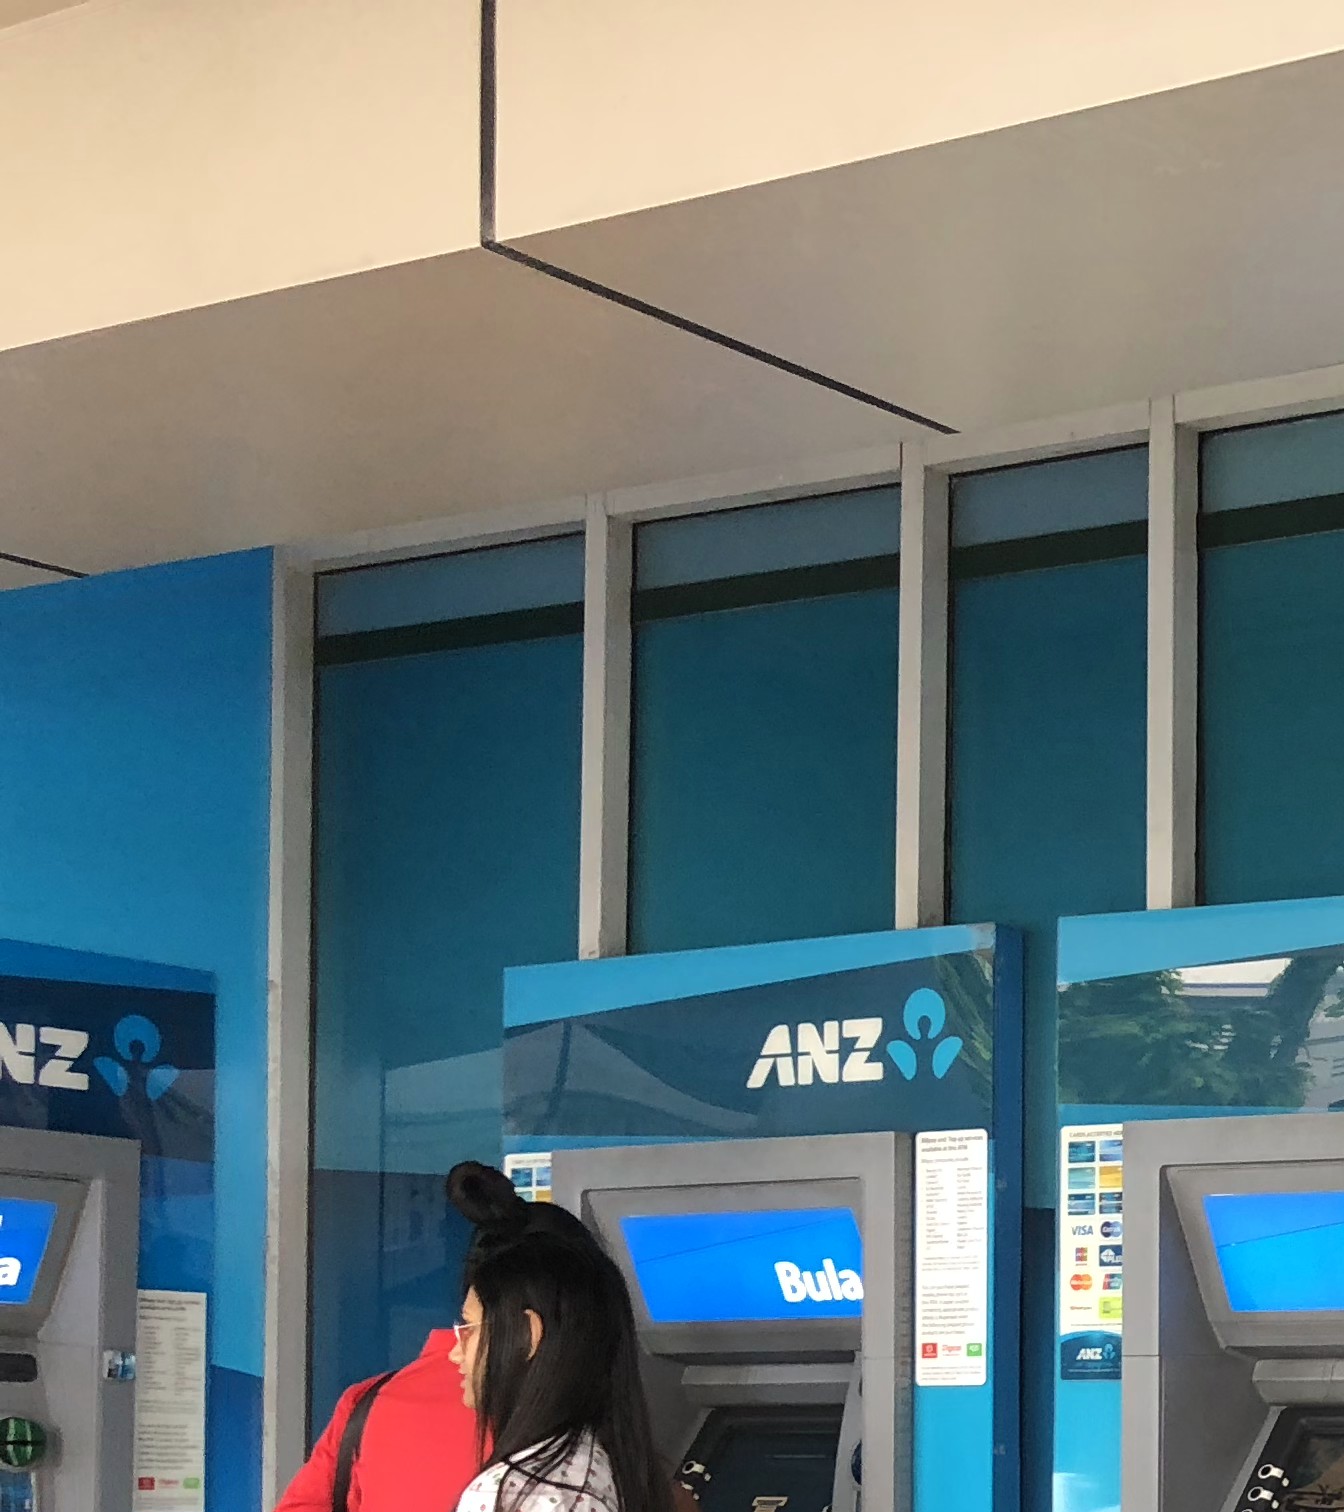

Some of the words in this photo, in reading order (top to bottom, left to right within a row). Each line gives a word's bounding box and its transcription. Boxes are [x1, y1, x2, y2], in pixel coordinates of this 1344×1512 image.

[746, 1017, 884, 1089] ANZ
[1071, 1225, 1094, 1236] VISA
[774, 1258, 864, 1303] Bula
[1076, 1347, 1103, 1360] ANZ
